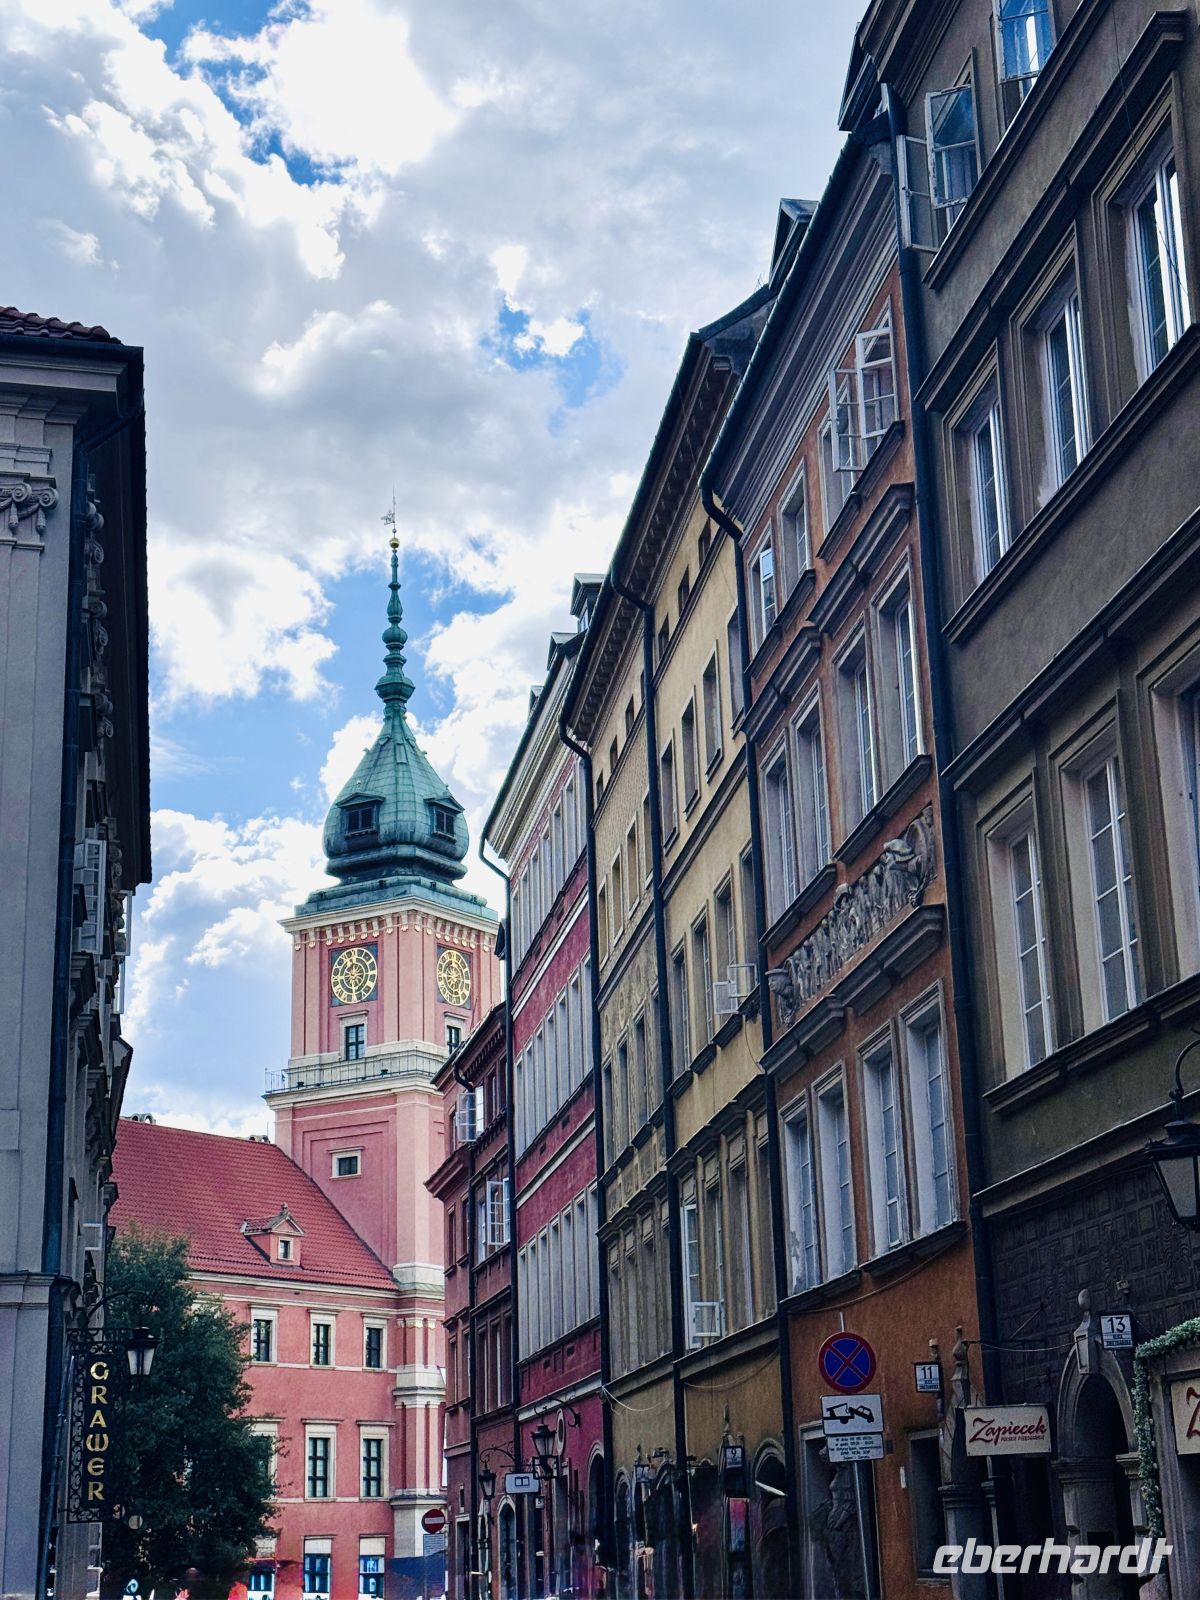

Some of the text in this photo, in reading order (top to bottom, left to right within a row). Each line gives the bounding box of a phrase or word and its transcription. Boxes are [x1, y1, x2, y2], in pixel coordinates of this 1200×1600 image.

[1107, 1316, 1125, 1333] 13
[921, 1366, 932, 1379] 11
[86, 1361, 110, 1501] GRAWER
[969, 1415, 1048, 1446] Zapiecek
[731, 1447, 737, 1458] 9
